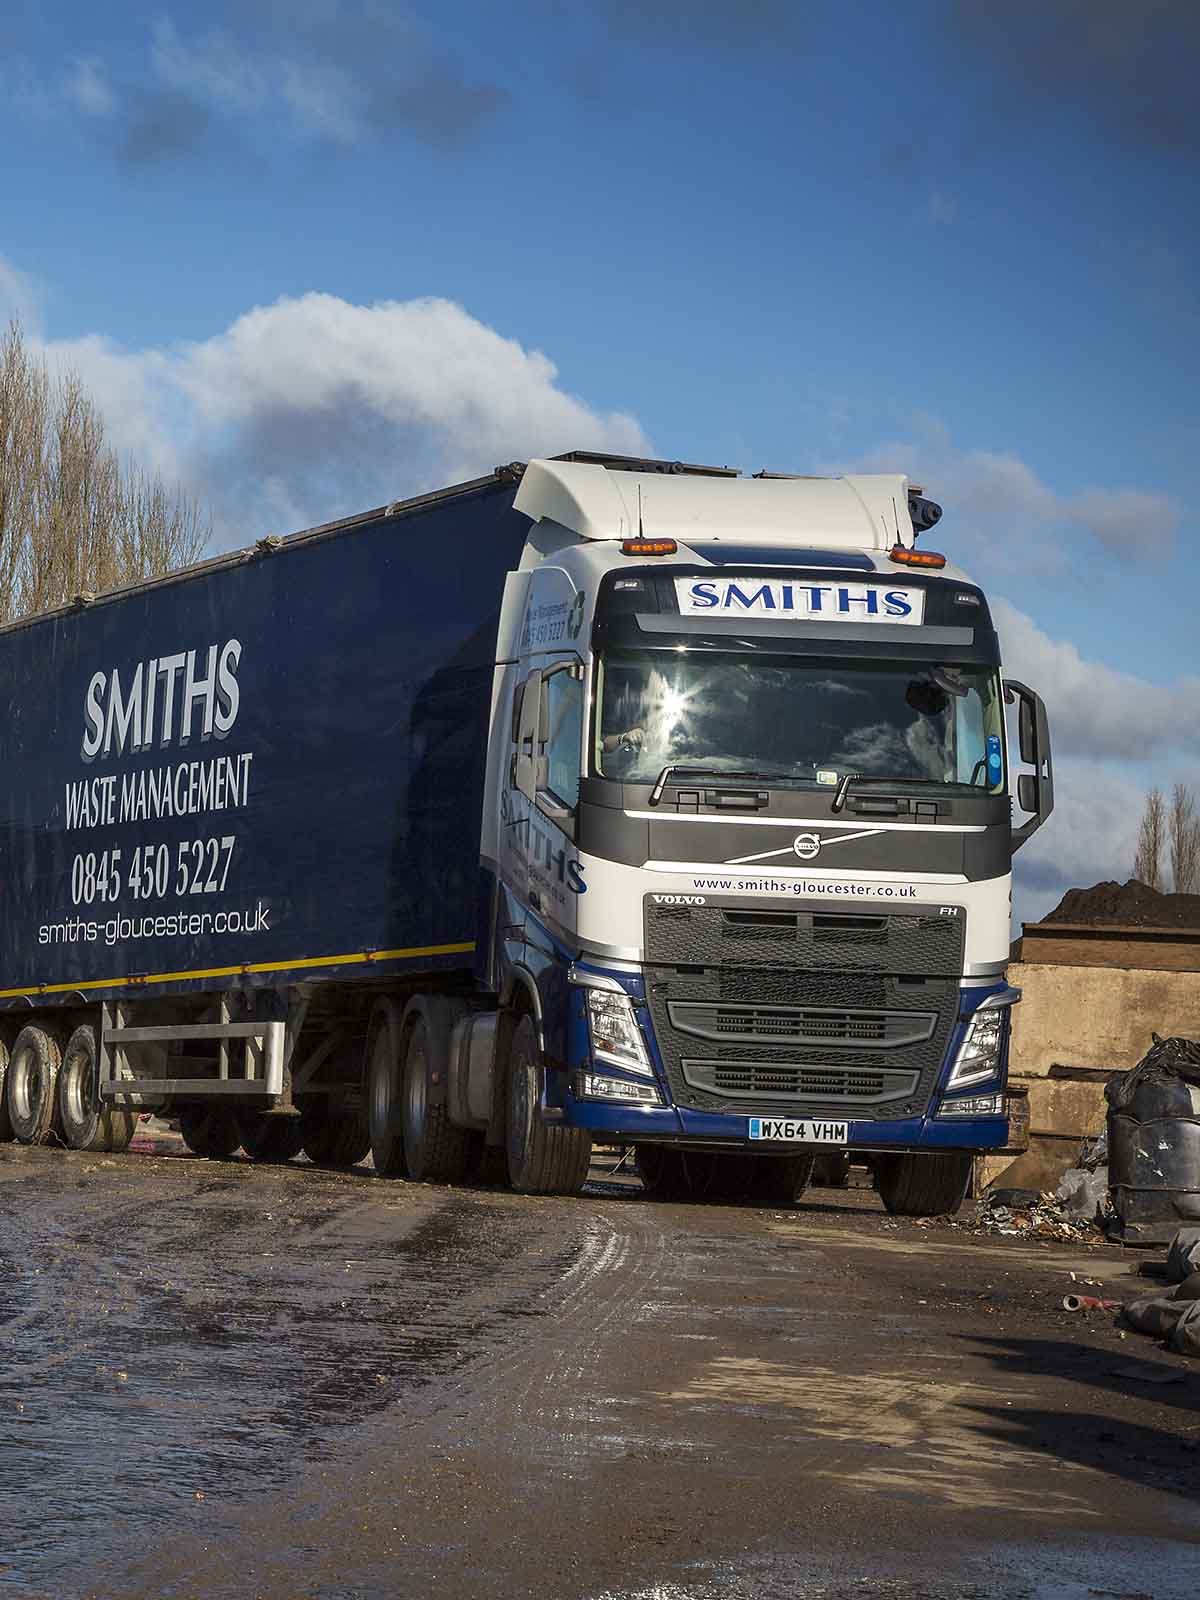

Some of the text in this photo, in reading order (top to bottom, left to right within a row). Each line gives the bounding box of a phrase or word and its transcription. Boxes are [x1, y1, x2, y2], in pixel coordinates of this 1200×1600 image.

[689, 583, 914, 617] SMITHS
[81, 638, 243, 763] SMITHS
[65, 752, 253, 831] WASTE MANAGEMENT
[71, 835, 236, 905] 0845 450 5227
[693, 877, 917, 898] www.smiths-gloucester.co.uk
[38, 901, 270, 946] smiths-gloucester.co.uk
[651, 894, 958, 916] VOLVO FH
[761, 1121, 846, 1140] WX64 VHM
